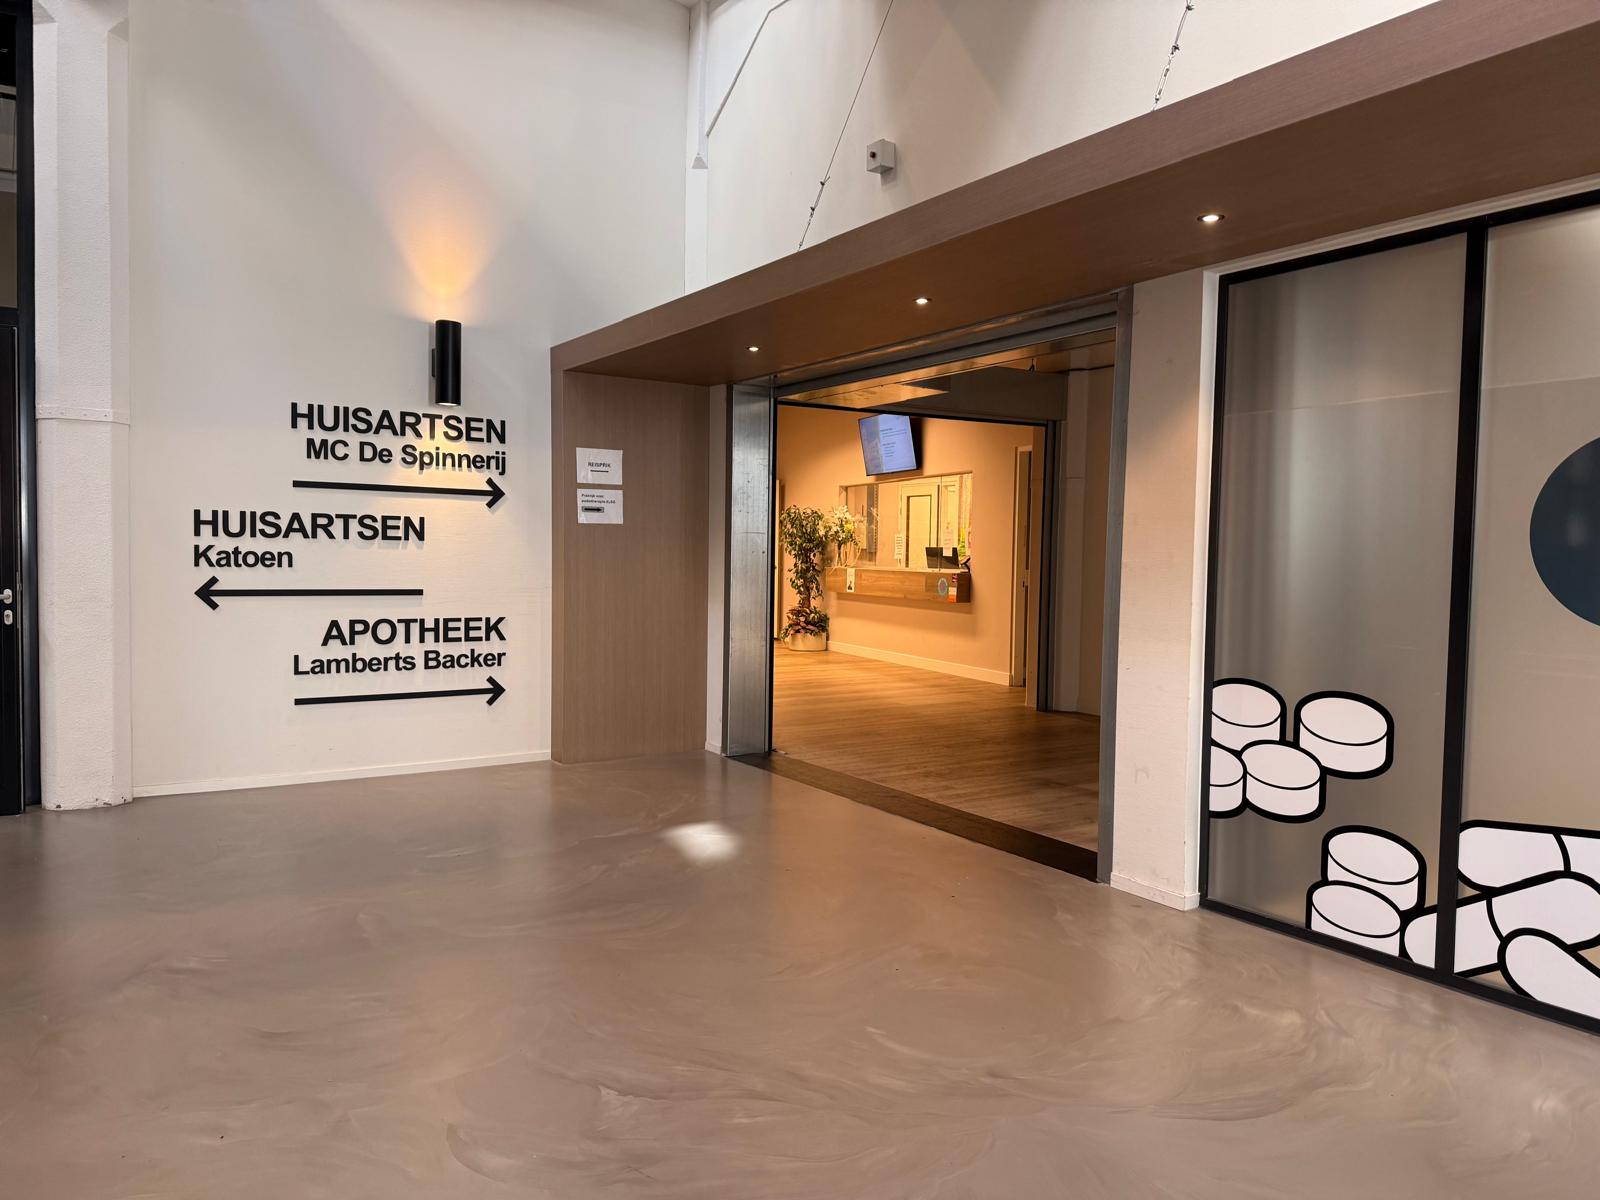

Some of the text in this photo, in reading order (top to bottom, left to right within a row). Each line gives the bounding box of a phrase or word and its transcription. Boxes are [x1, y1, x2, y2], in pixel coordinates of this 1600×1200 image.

[291, 402, 506, 444] HUISARTSEN
[306, 438, 507, 476] MC De Spinnerij
[193, 509, 425, 542] HUISARTSEN
[193, 545, 294, 569] Katoen
[321, 617, 507, 646] APOTHEEK
[293, 649, 507, 676] Lamberts Backer
